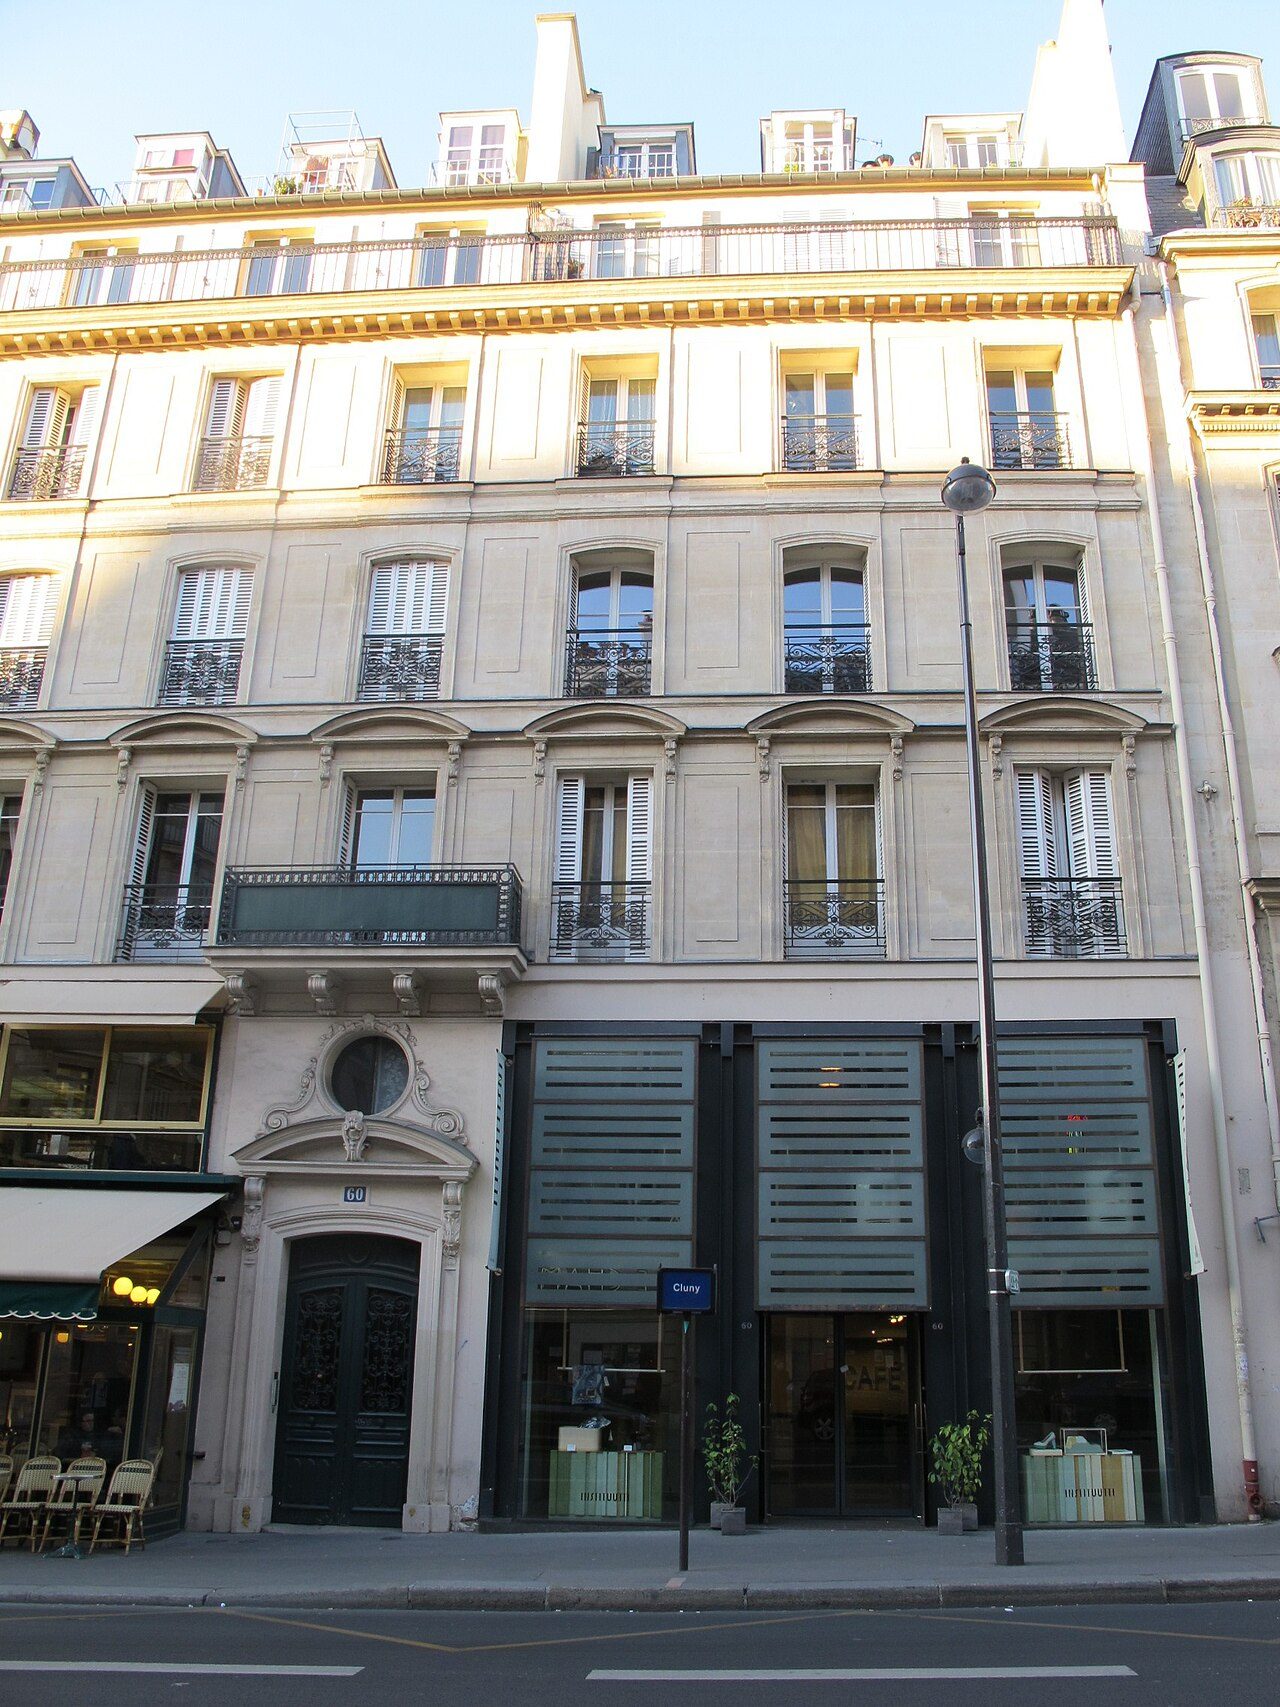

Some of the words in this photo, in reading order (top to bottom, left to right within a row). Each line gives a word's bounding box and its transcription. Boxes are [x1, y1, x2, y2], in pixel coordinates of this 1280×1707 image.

[346, 1187, 364, 1201] 60
[672, 1282, 701, 1295] Cluny
[741, 1322, 753, 1330] 60
[932, 1322, 944, 1330] 60
